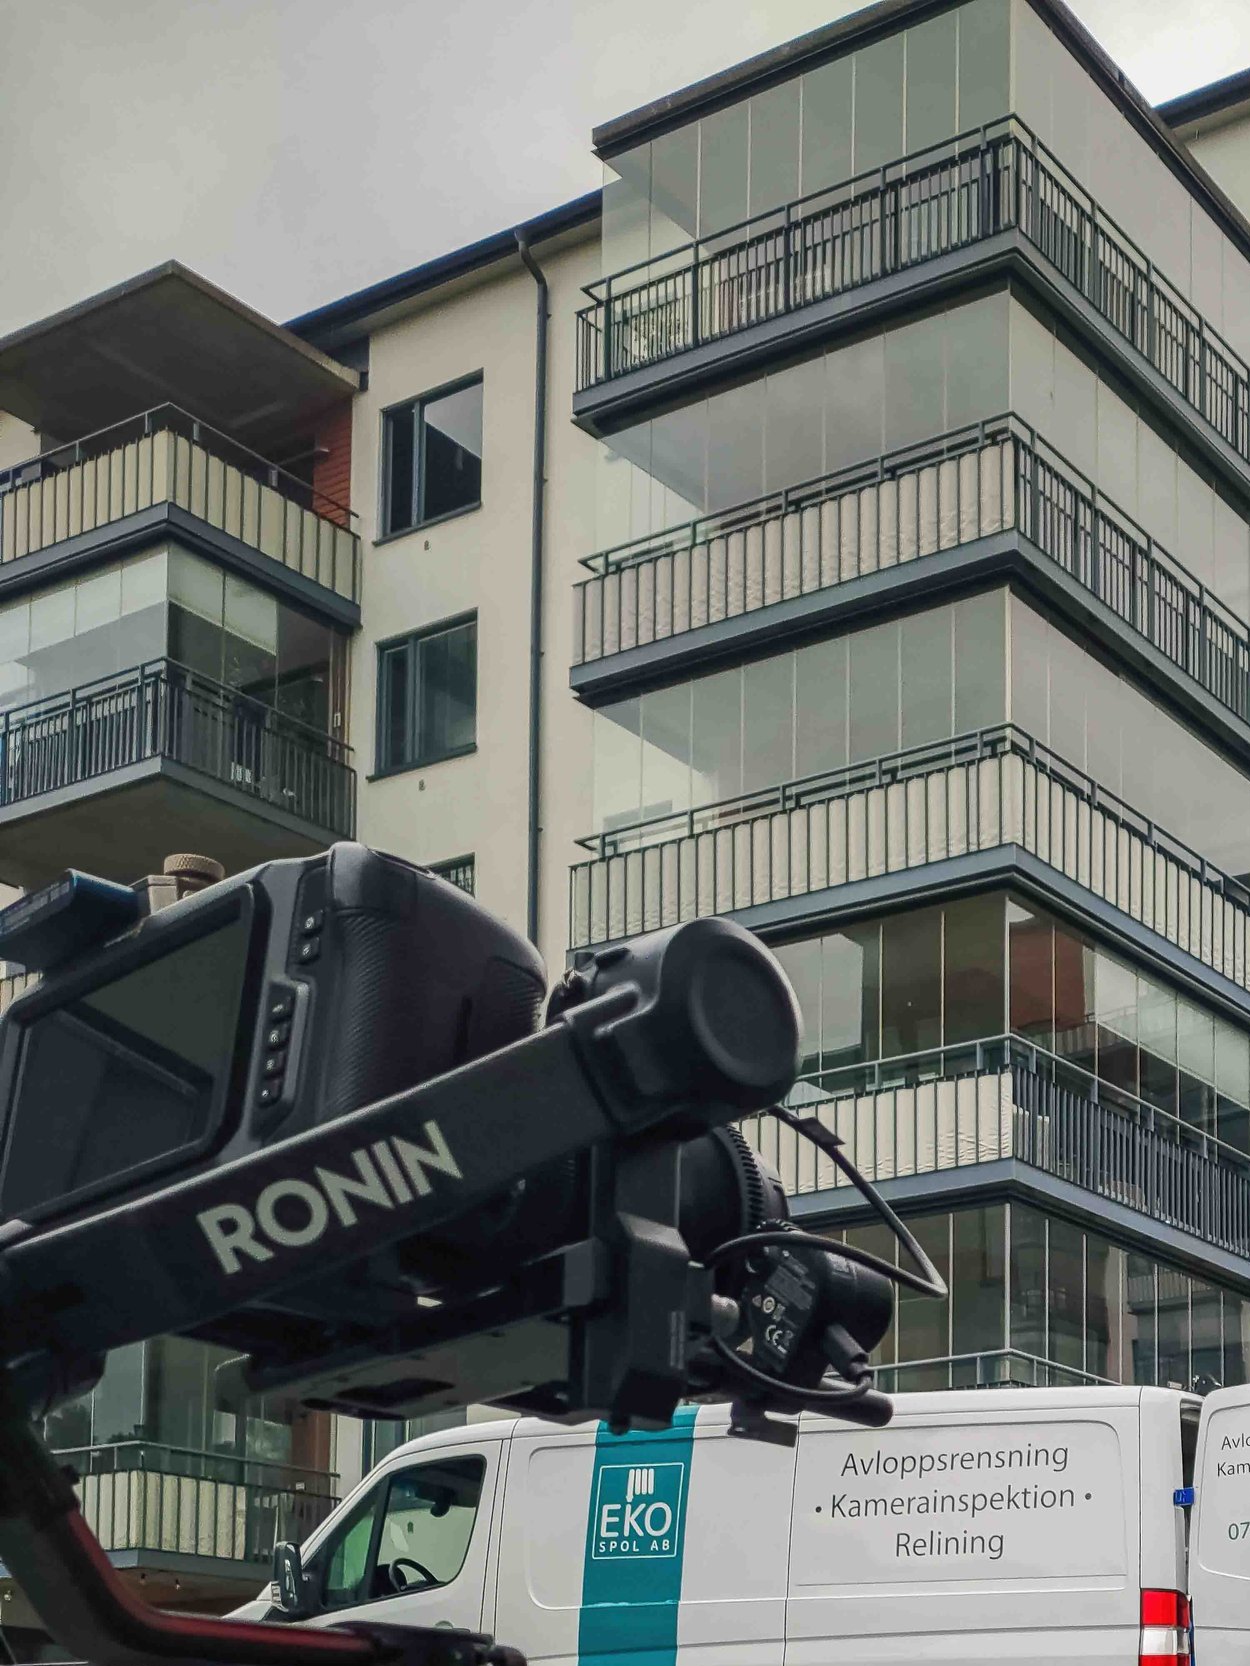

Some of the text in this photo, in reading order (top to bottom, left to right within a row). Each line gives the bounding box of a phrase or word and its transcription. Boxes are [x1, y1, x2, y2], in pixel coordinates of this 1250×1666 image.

[196, 1119, 464, 1277] RONIN
[840, 1442, 1070, 1480] Avloppsrensning
[600, 1502, 673, 1538] EKO
[829, 1485, 1076, 1520] Kamerainspektion
[598, 1539, 670, 1553] SPOL AB
[894, 1528, 1006, 1561] Relining
